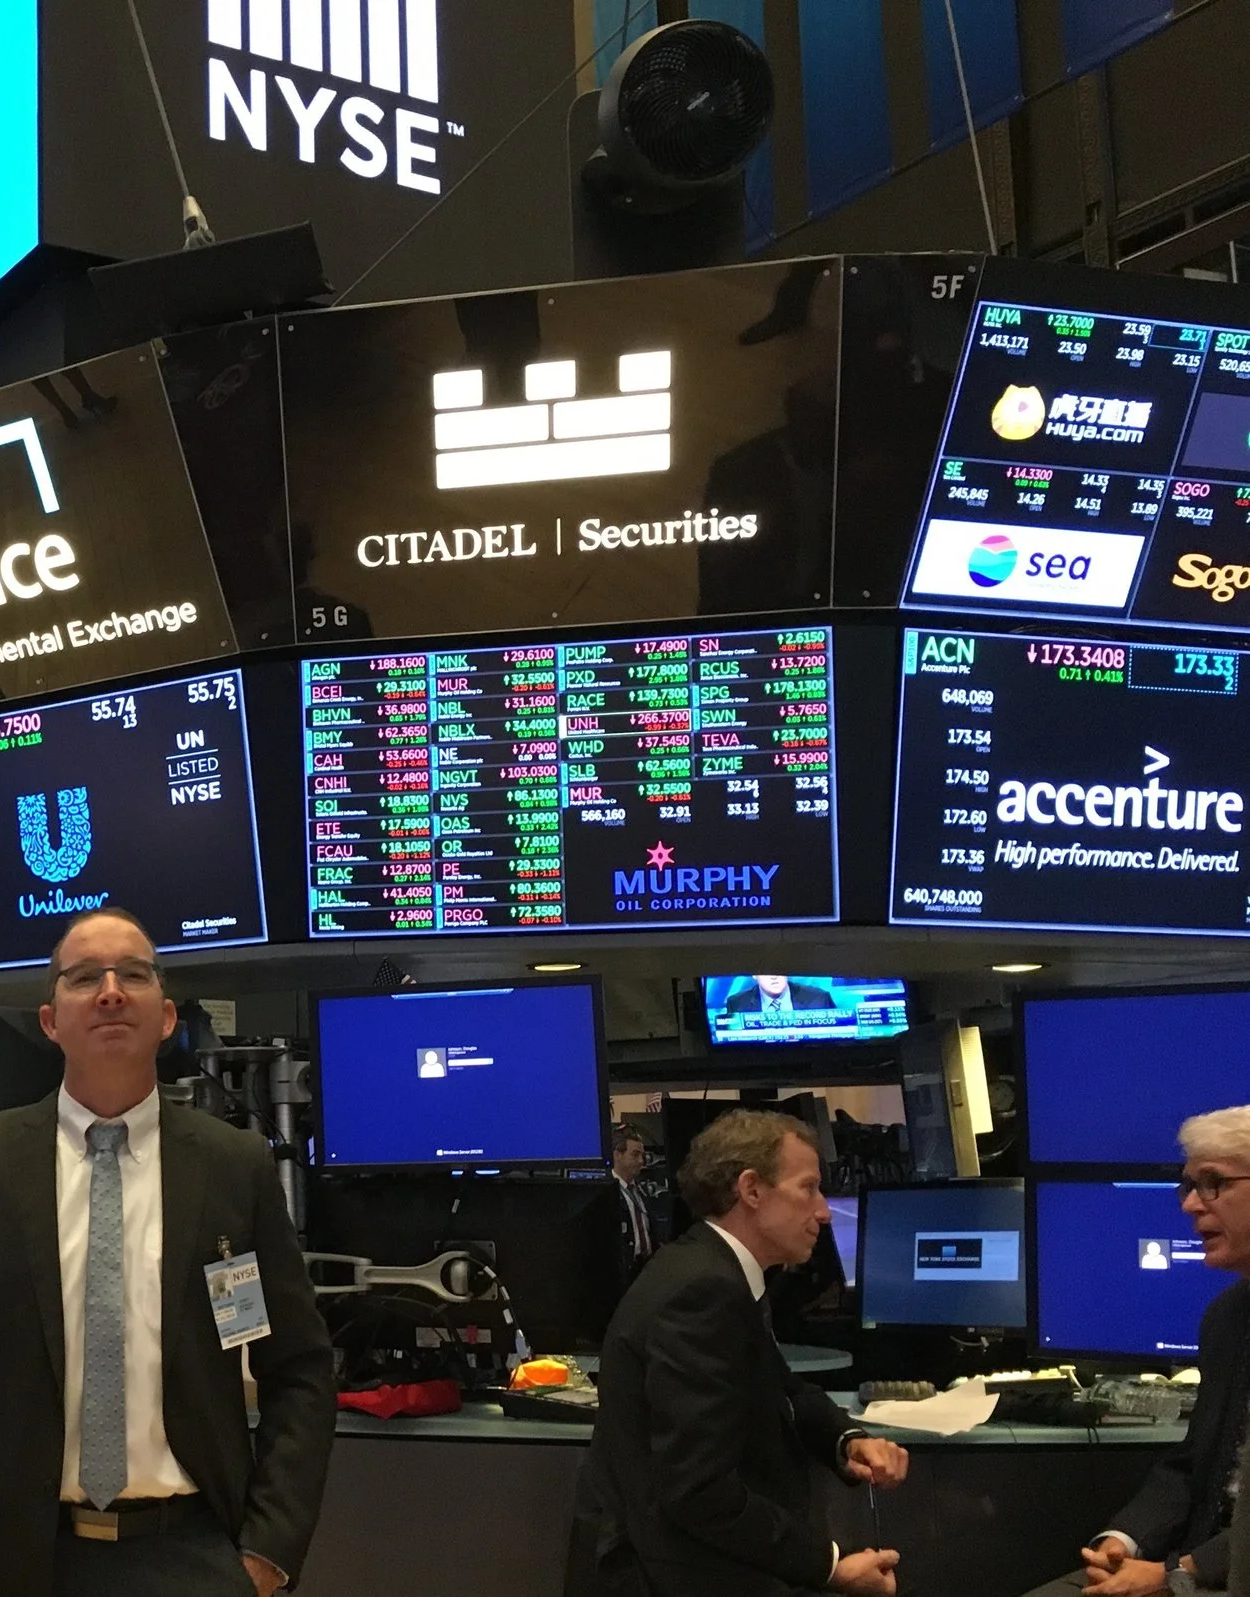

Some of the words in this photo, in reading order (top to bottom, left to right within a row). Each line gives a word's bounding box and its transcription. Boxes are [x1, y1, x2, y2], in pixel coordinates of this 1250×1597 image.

[208, 57, 442, 196] NYSE
[984, 307, 1021, 326] HUYA
[1054, 314, 1094, 330] 23.7000
[1123, 322, 1151, 336] 23.59
[1215, 332, 1250, 349] SPOT
[979, 333, 1029, 350] 1,413,171
[1058, 341, 1086, 355] 23.50
[1172, 354, 1201, 368] 23.15
[943, 461, 963, 476] SE
[1012, 467, 1053, 480] 14.3300
[948, 486, 989, 502] 245,845
[1173, 481, 1210, 497] SOGO
[1176, 506, 1213, 521] 395,221
[357, 524, 536, 568] CITADEL
[579, 508, 758, 552] Securities
[1025, 551, 1092, 581] sea
[66, 602, 197, 648] Exchange
[437, 655, 467, 668] MNK
[511, 649, 554, 662] 29.6100
[566, 646, 606, 660] PUMP
[643, 640, 687, 653] 17.4900
[921, 636, 975, 664] ACN
[1040, 644, 1125, 669] 173.3408
[1174, 653, 1234, 677] 173.33
[312, 662, 340, 676] AGN
[377, 657, 425, 670] 188.1600
[700, 661, 740, 676] RCUS
[780, 655, 826, 669] 13.7200
[921, 663, 958, 674] Accenture
[437, 678, 467, 691] MUR
[511, 672, 554, 685] 32.5500
[91, 696, 136, 721] 55.74
[187, 677, 235, 703] 55.75
[567, 693, 605, 707] RACE
[637, 688, 689, 701] 139.7300
[941, 688, 994, 706] 648,069
[313, 708, 350, 722] BHVN
[385, 703, 426, 715] 36.9800
[567, 717, 599, 730] UNH
[638, 711, 689, 724] 266.3700
[176, 730, 205, 749] UN
[948, 729, 991, 745] 173.54
[168, 756, 219, 778] LISTED
[703, 757, 743, 771] ZYME
[782, 752, 828, 764] 15.9900
[945, 769, 989, 785] 174.50
[170, 782, 222, 805] NYSE
[581, 809, 626, 822] 566,160
[659, 805, 691, 819] 32.91
[727, 802, 759, 816] 33.13
[796, 799, 829, 813] 32.39
[996, 776, 1243, 832] accenture
[943, 809, 987, 825] 172.60
[941, 849, 985, 864] 173.36
[994, 840, 1036, 868] High
[1037, 842, 1155, 870] performance.
[1157, 847, 1240, 872] Delivered.
[614, 864, 780, 895] MURPHY
[19, 889, 109, 918] Unilever
[616, 900, 642, 911] OIL
[651, 896, 771, 910] CORPORATION
[904, 888, 983, 906] 640,748,000
[181, 919, 204, 930] Citadel
[205, 916, 237, 929] Securities
[444, 908, 483, 922] PRGO
[518, 905, 561, 917] 72.3580
[233, 1267, 257, 1282] NYSE
